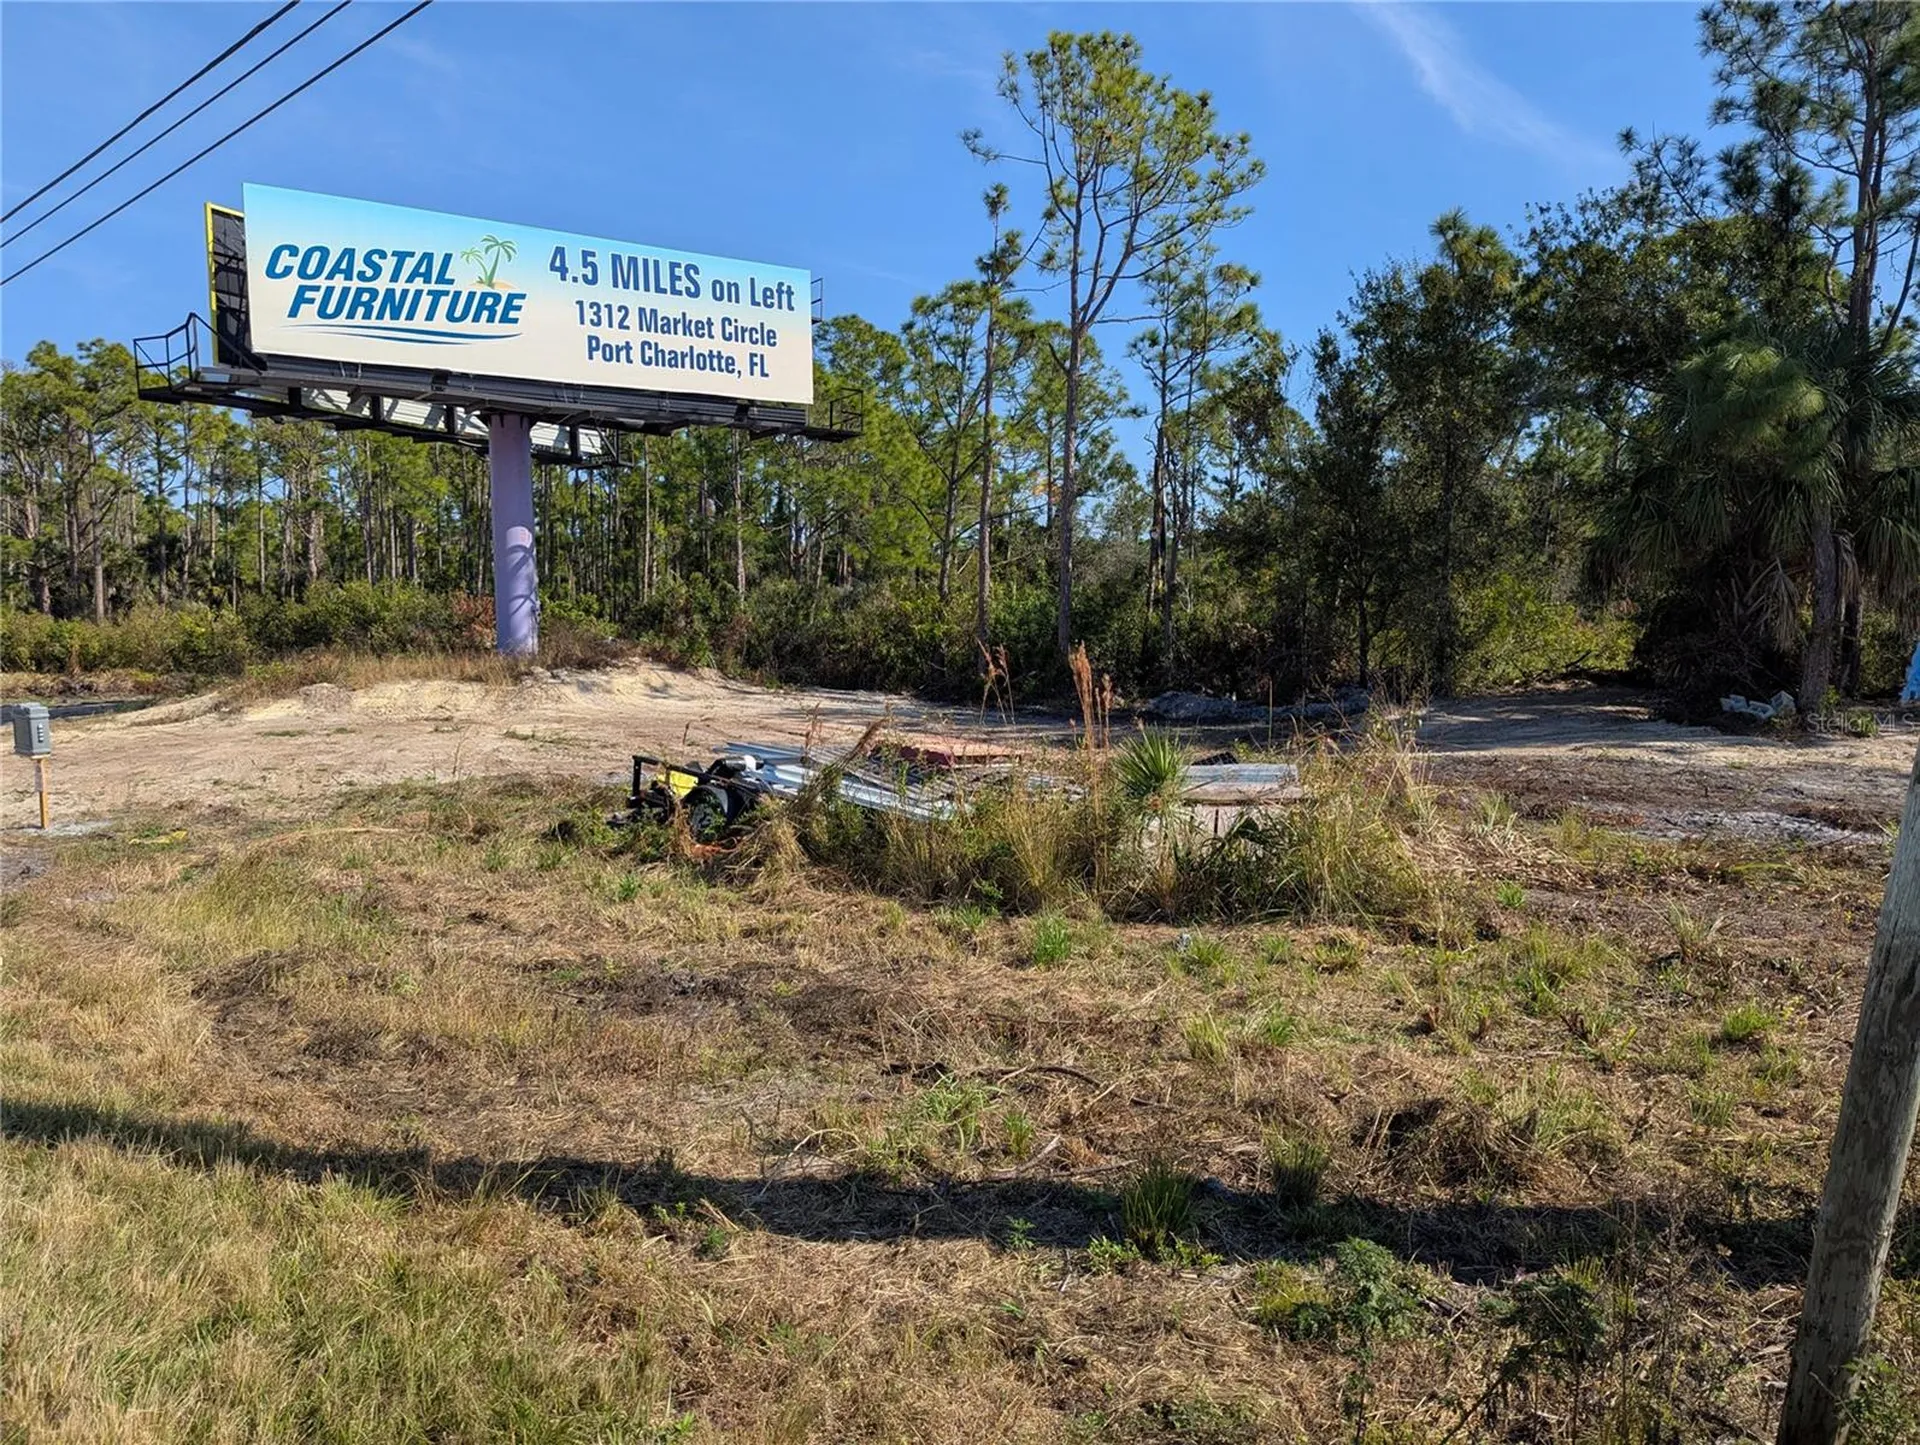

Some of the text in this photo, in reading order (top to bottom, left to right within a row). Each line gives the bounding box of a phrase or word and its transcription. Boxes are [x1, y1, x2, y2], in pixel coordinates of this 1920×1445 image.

[265, 244, 456, 286] COASTAL
[549, 246, 796, 311] 4.5 MILES on Left
[286, 284, 527, 324] FURNITURE
[575, 300, 778, 347] 1312 Market Circle
[587, 335, 770, 379] Port Charlotte, FL
